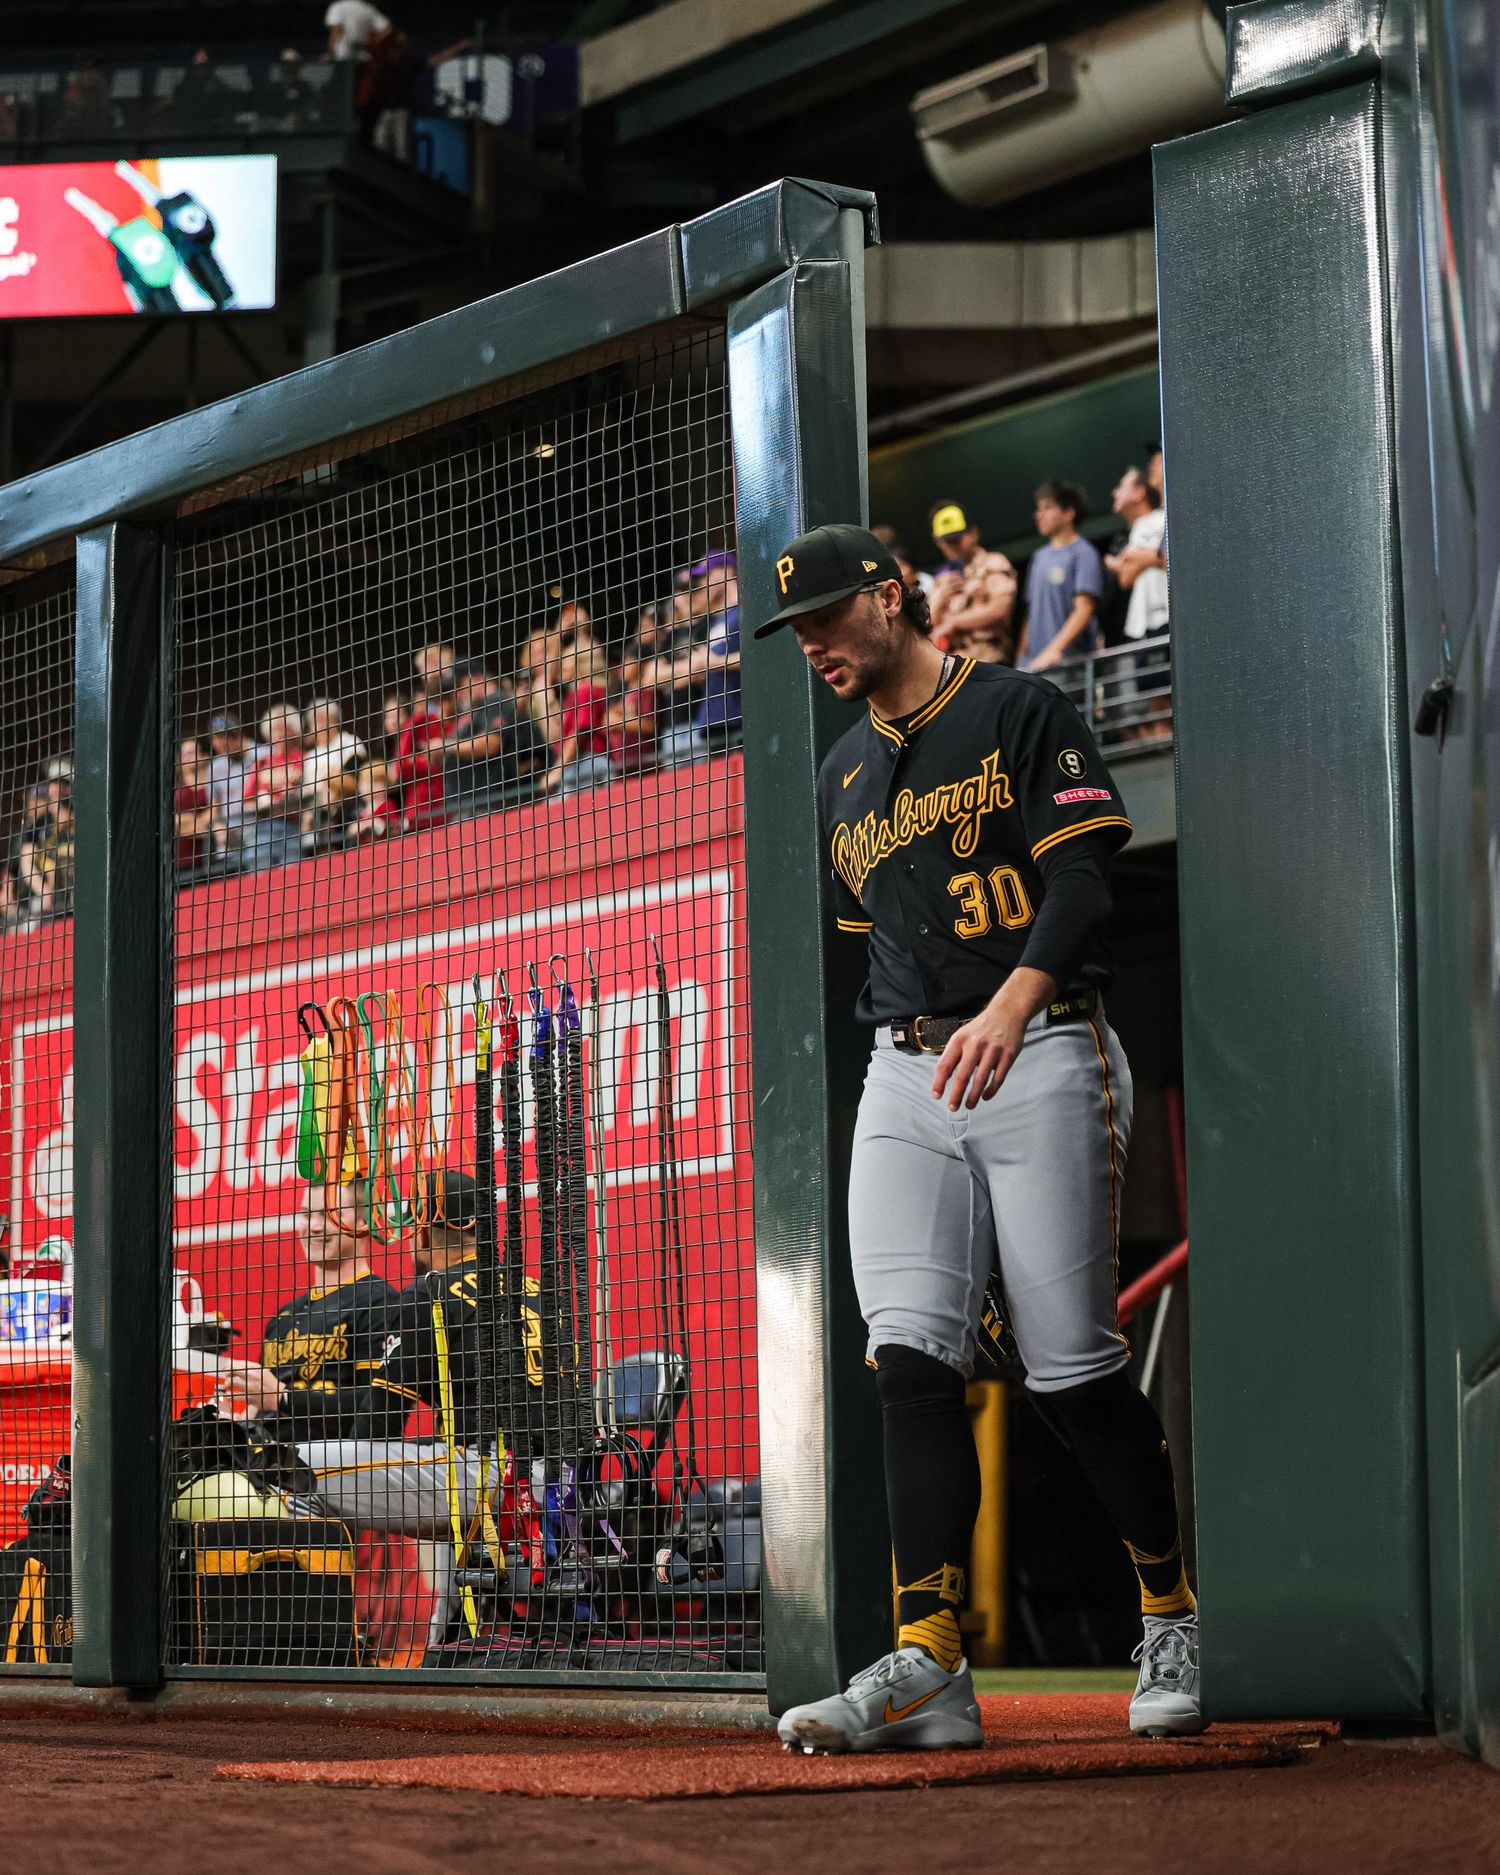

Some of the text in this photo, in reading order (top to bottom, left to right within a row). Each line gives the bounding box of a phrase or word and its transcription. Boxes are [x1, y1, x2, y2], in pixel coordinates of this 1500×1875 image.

[776, 555, 795, 594] P
[1065, 753, 1081, 774] 9
[1058, 790, 1108, 802] SHEETZ
[831, 748, 1015, 904] Pittsburgh
[946, 865, 1035, 939] 30
[173, 1005, 420, 1201] Stae
